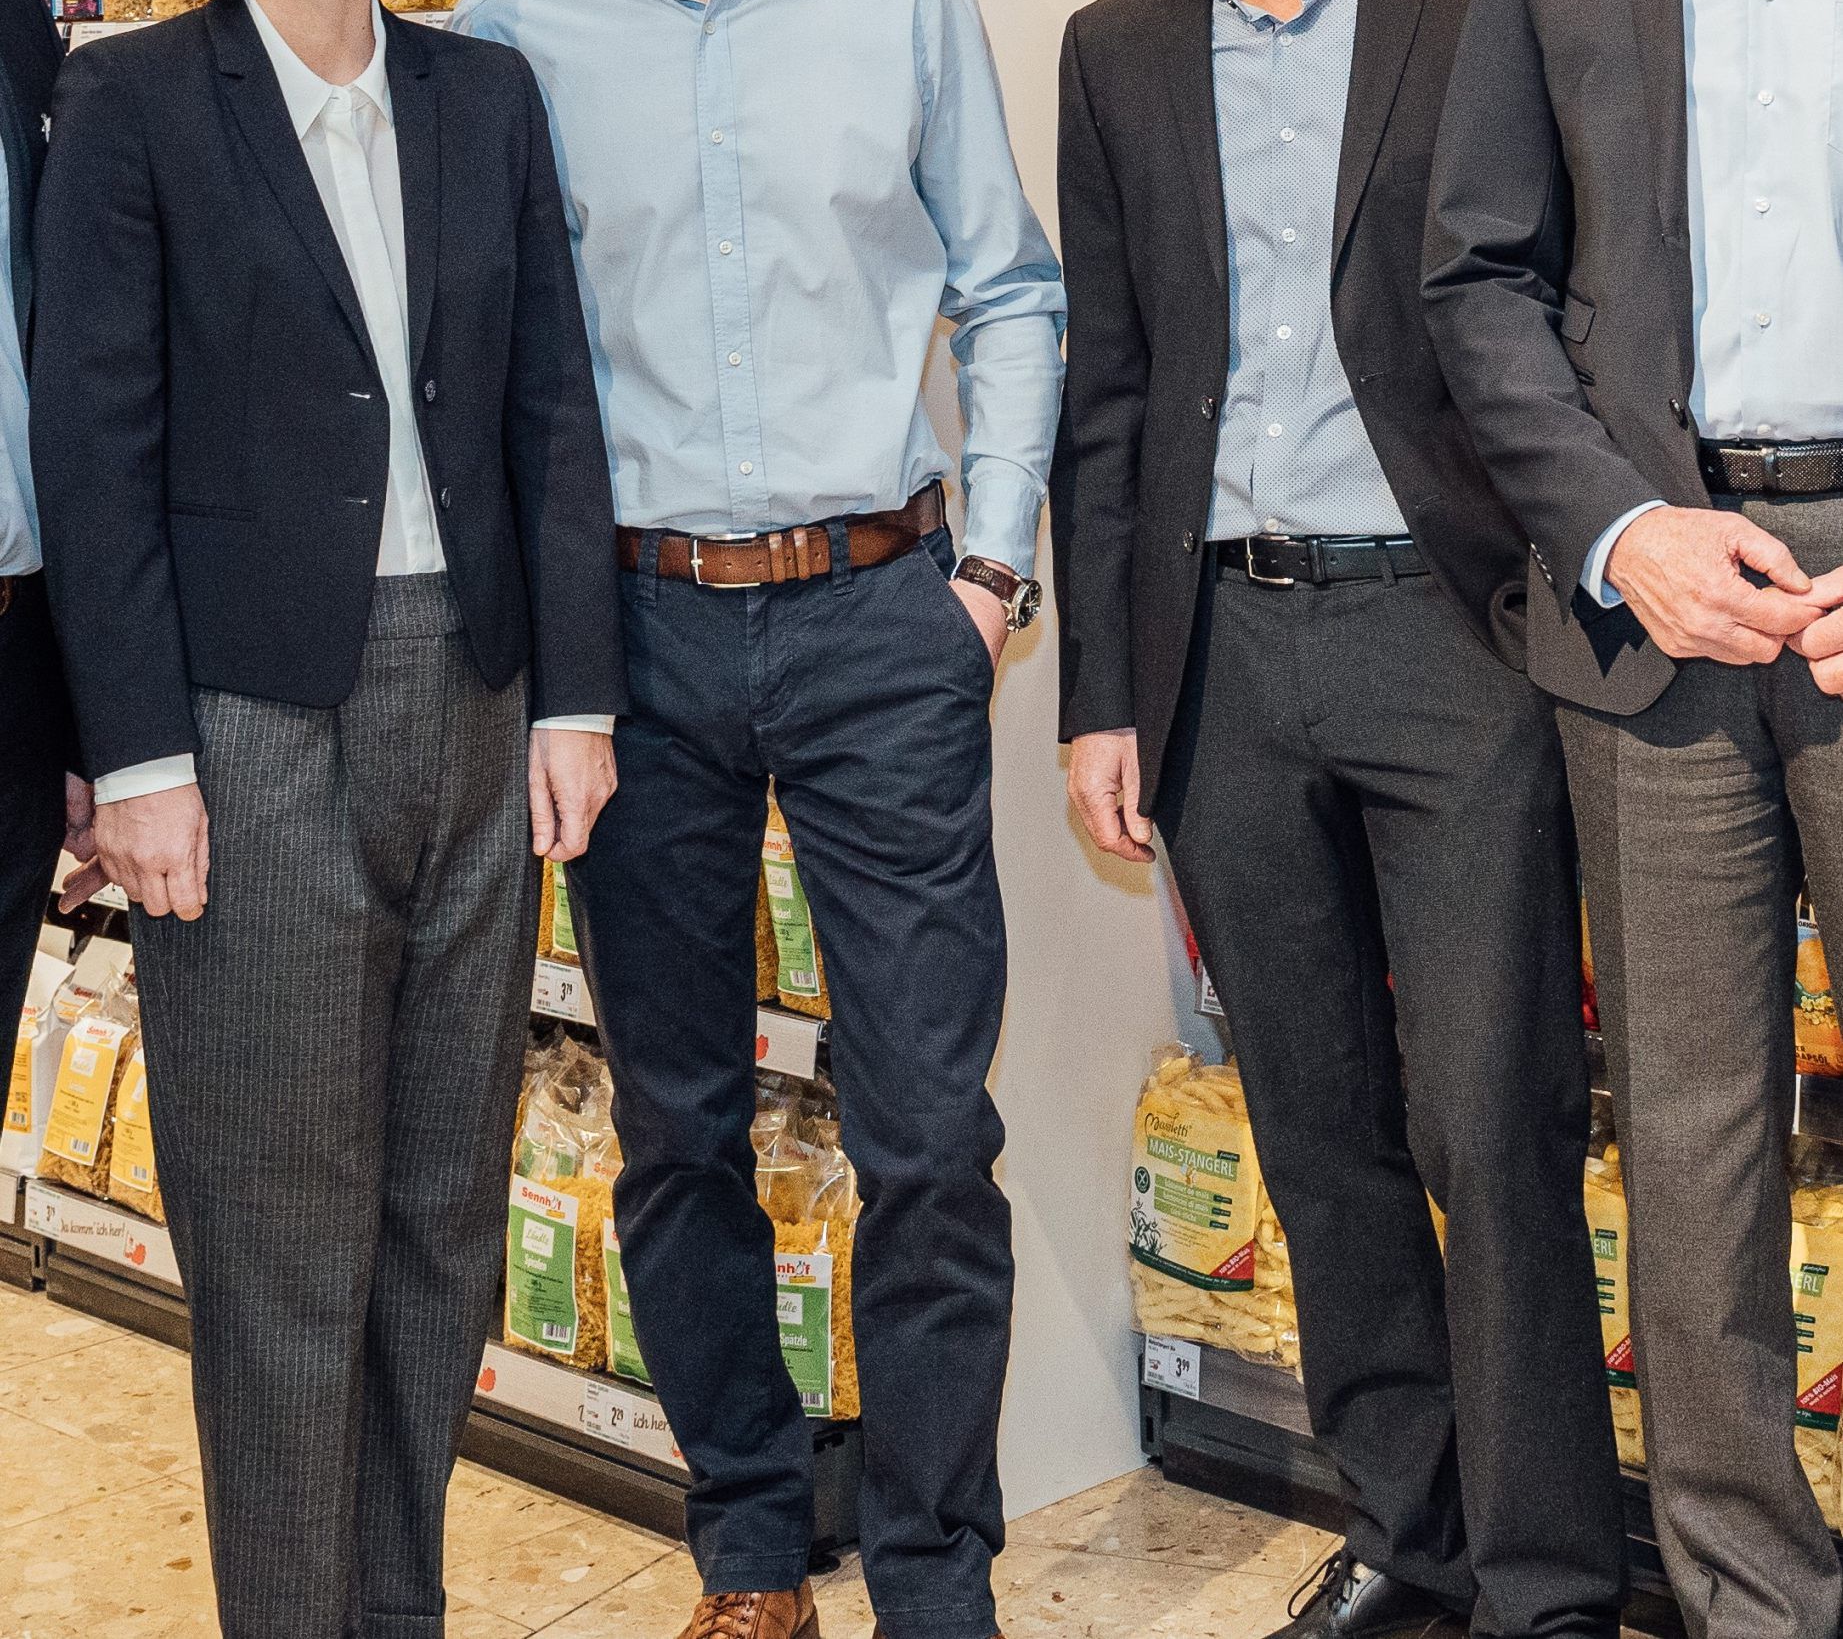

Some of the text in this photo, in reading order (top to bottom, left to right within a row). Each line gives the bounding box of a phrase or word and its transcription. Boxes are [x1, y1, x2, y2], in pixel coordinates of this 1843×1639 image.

[1149, 1139, 1234, 1177] MAIS-STANGERL
[521, 1185, 562, 1211] Sennhof
[777, 1259, 811, 1276] nhof
[779, 1333, 808, 1347] Spätzle
[633, 1412, 668, 1432] ich her
